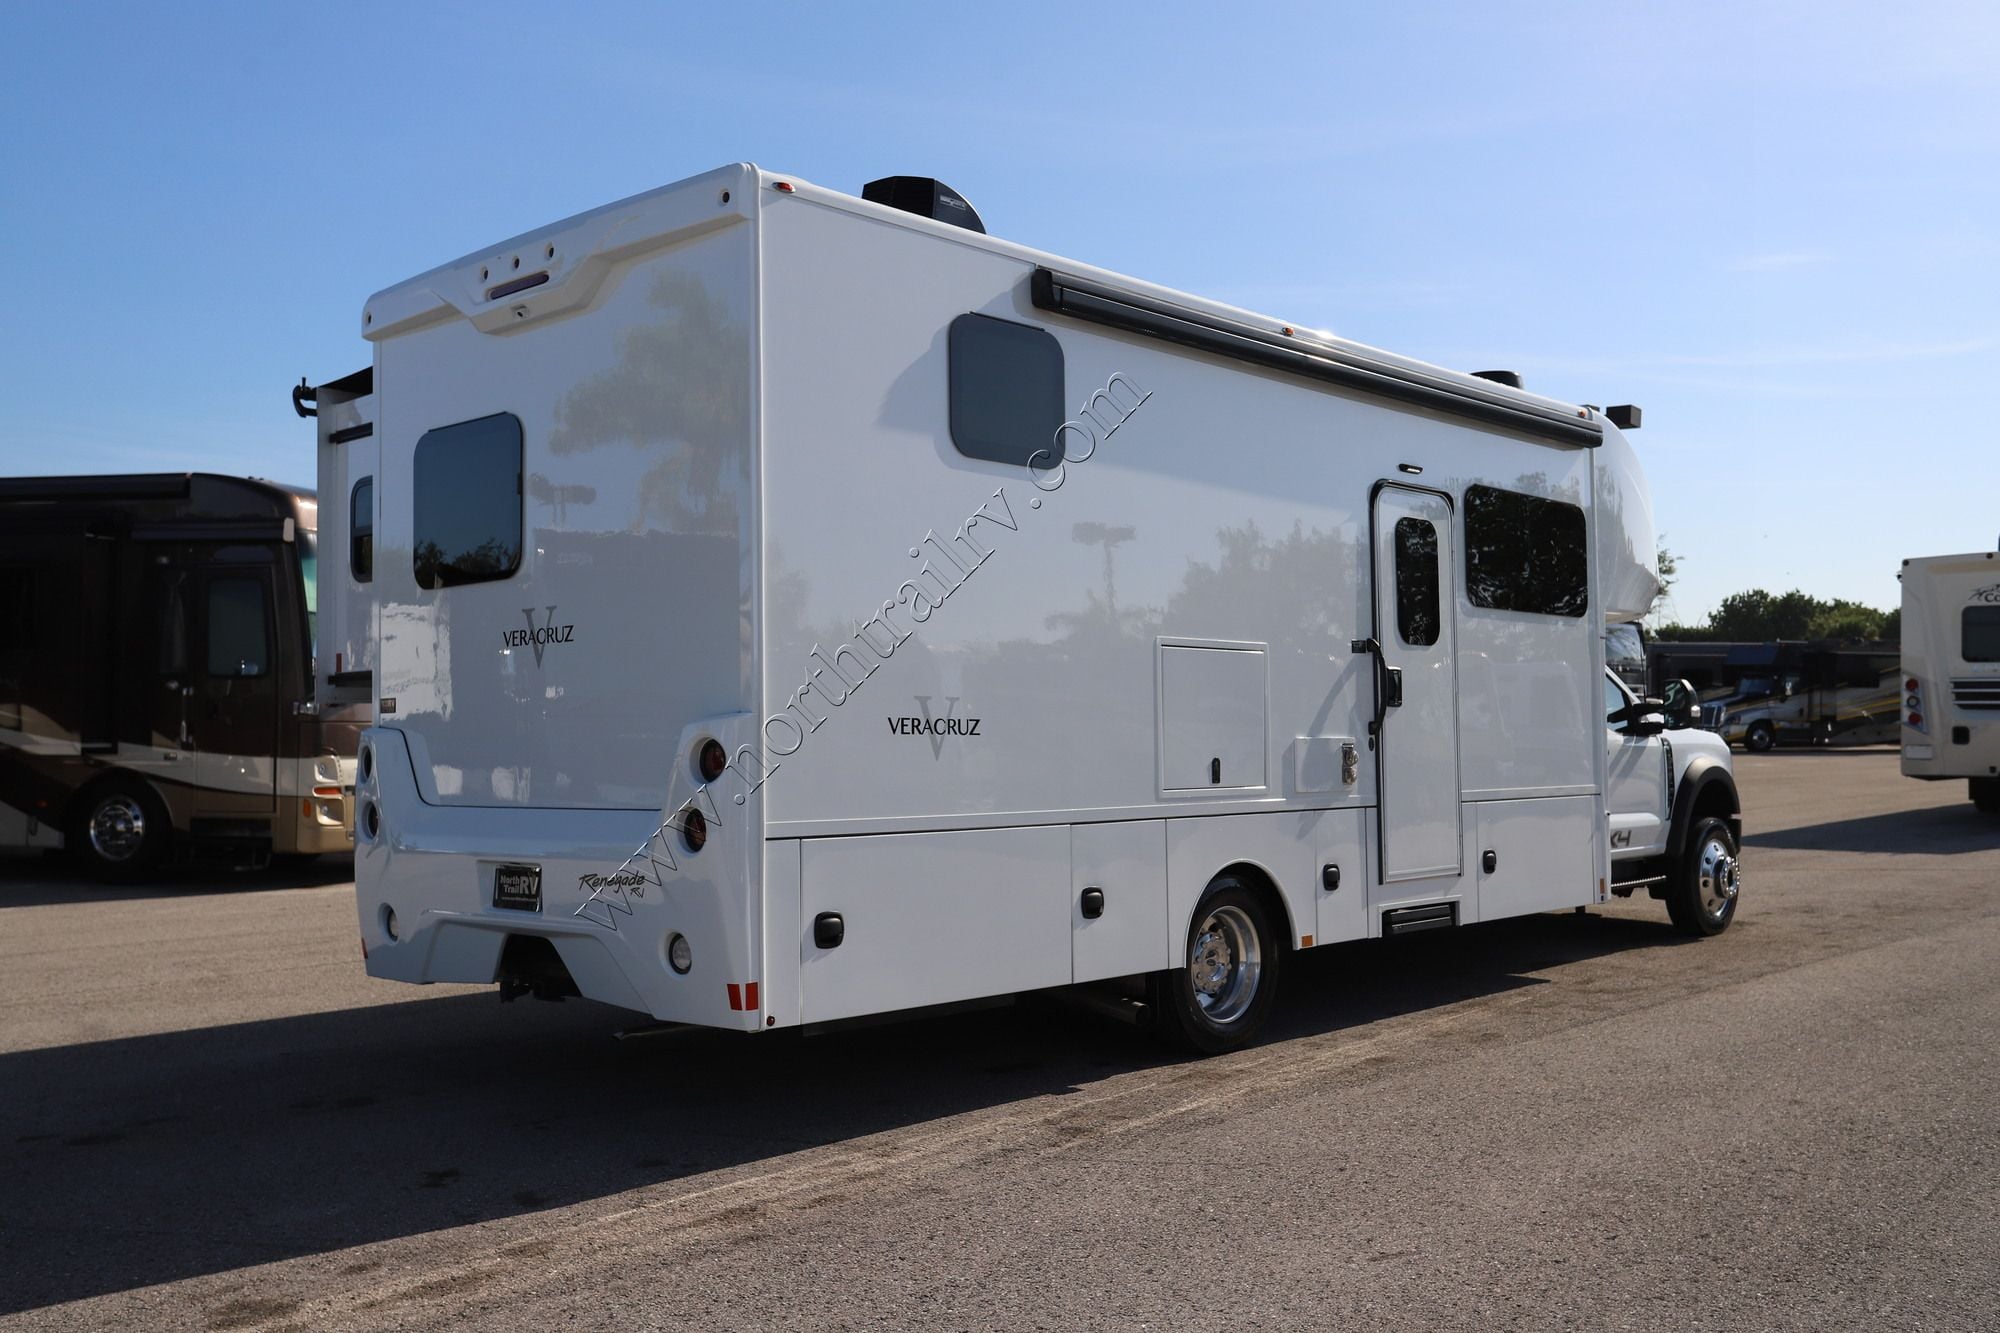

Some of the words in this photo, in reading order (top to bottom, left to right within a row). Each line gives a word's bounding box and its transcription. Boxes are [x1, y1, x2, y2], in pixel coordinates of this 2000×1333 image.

[503, 625, 574, 647] VERACRUZ
[888, 717, 981, 735] VERACRUZ
[500, 874, 520, 885] North
[519, 876, 539, 895] RV
[579, 869, 646, 894] Renegade
